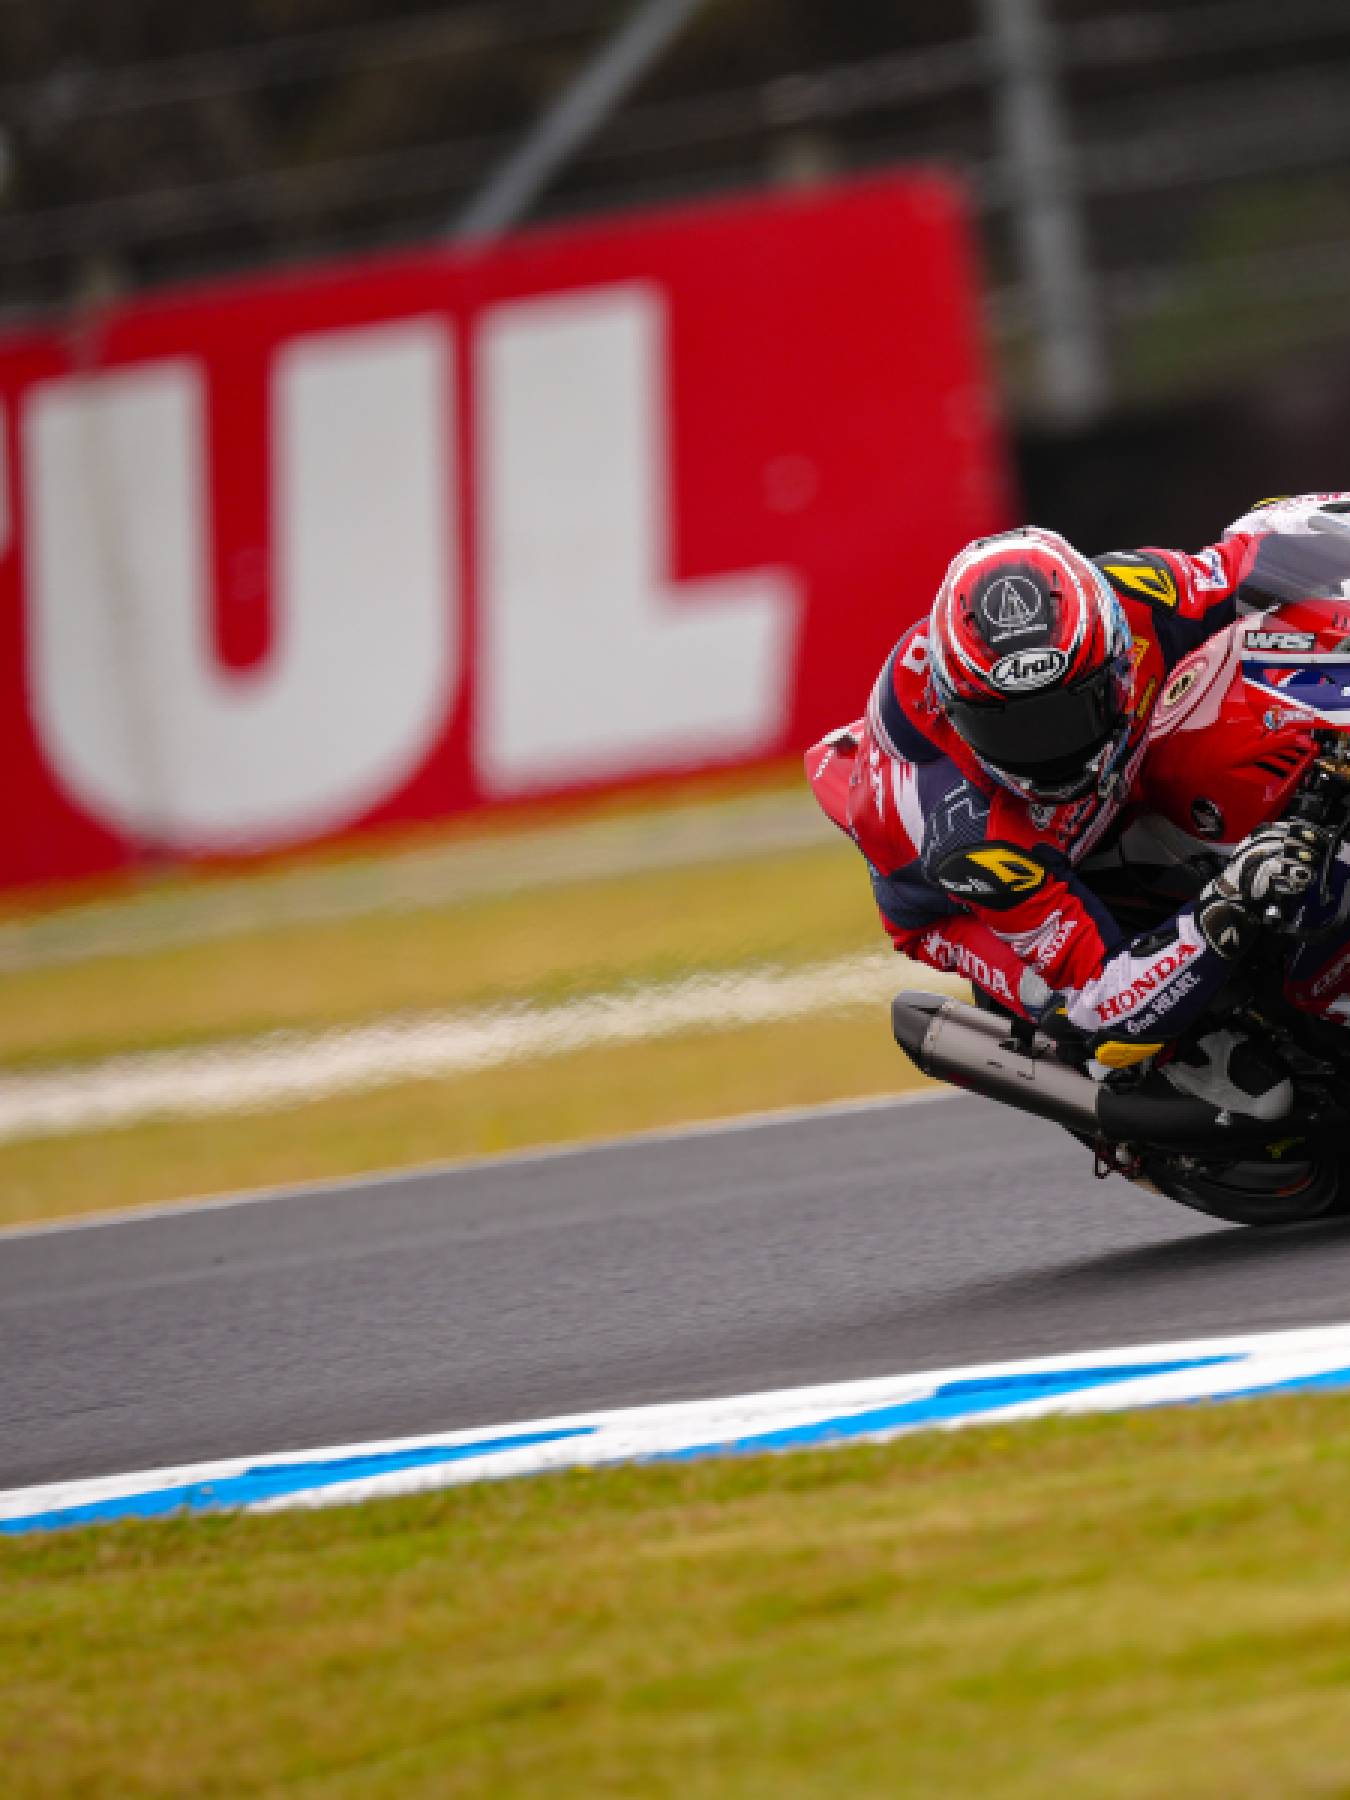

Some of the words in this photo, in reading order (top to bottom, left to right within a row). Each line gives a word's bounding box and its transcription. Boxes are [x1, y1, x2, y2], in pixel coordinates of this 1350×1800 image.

[0, 278, 800, 856] UL
[1004, 652, 1062, 683] Arai
[1094, 942, 1199, 1023] HONDA
